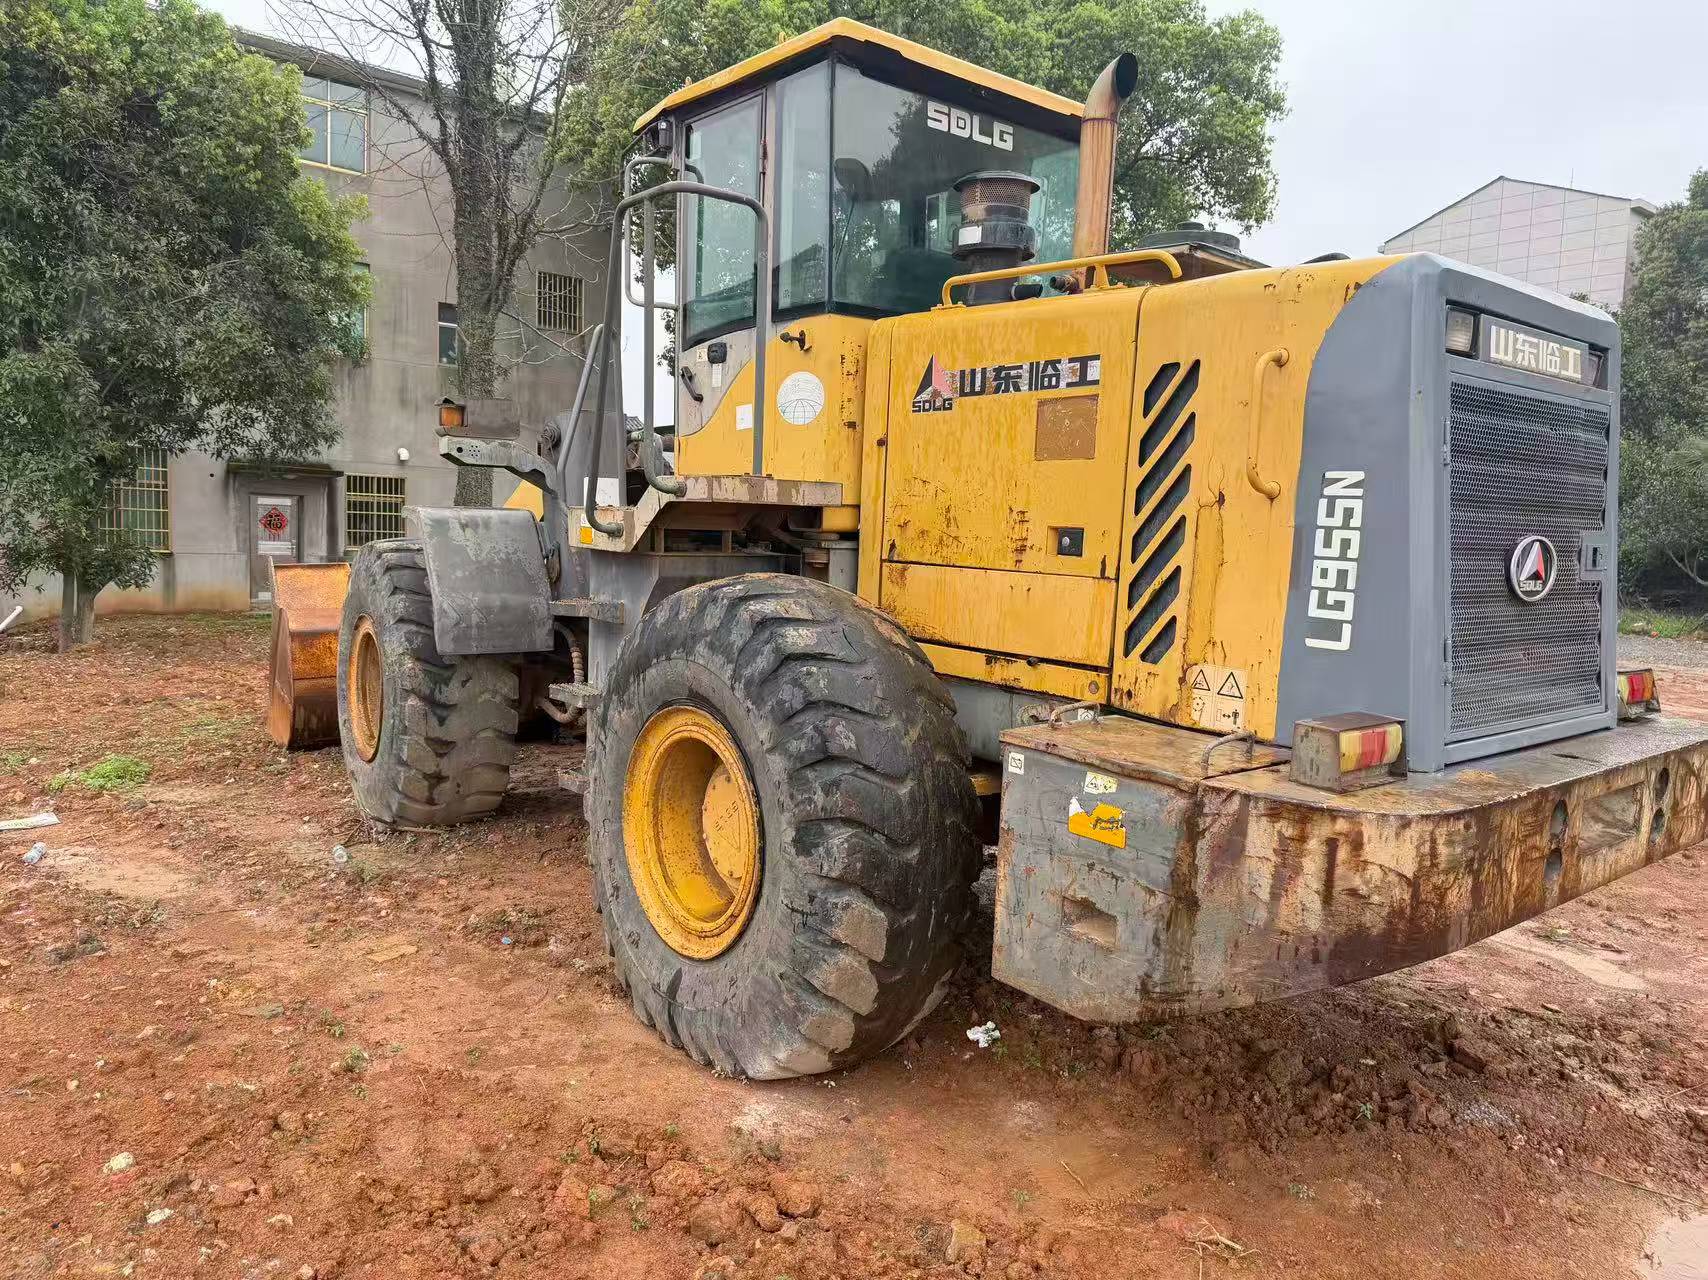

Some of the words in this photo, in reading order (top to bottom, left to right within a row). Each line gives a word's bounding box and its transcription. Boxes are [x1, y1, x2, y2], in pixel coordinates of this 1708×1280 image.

[927, 100, 1014, 152] SDLG
[1490, 325, 1582, 380] 山东临工
[959, 354, 1101, 398] 山东临工
[911, 398, 953, 413] SDLG
[267, 512, 283, 529] 福
[1304, 470, 1366, 651] LG955N
[1520, 580, 1544, 591] SDLG
